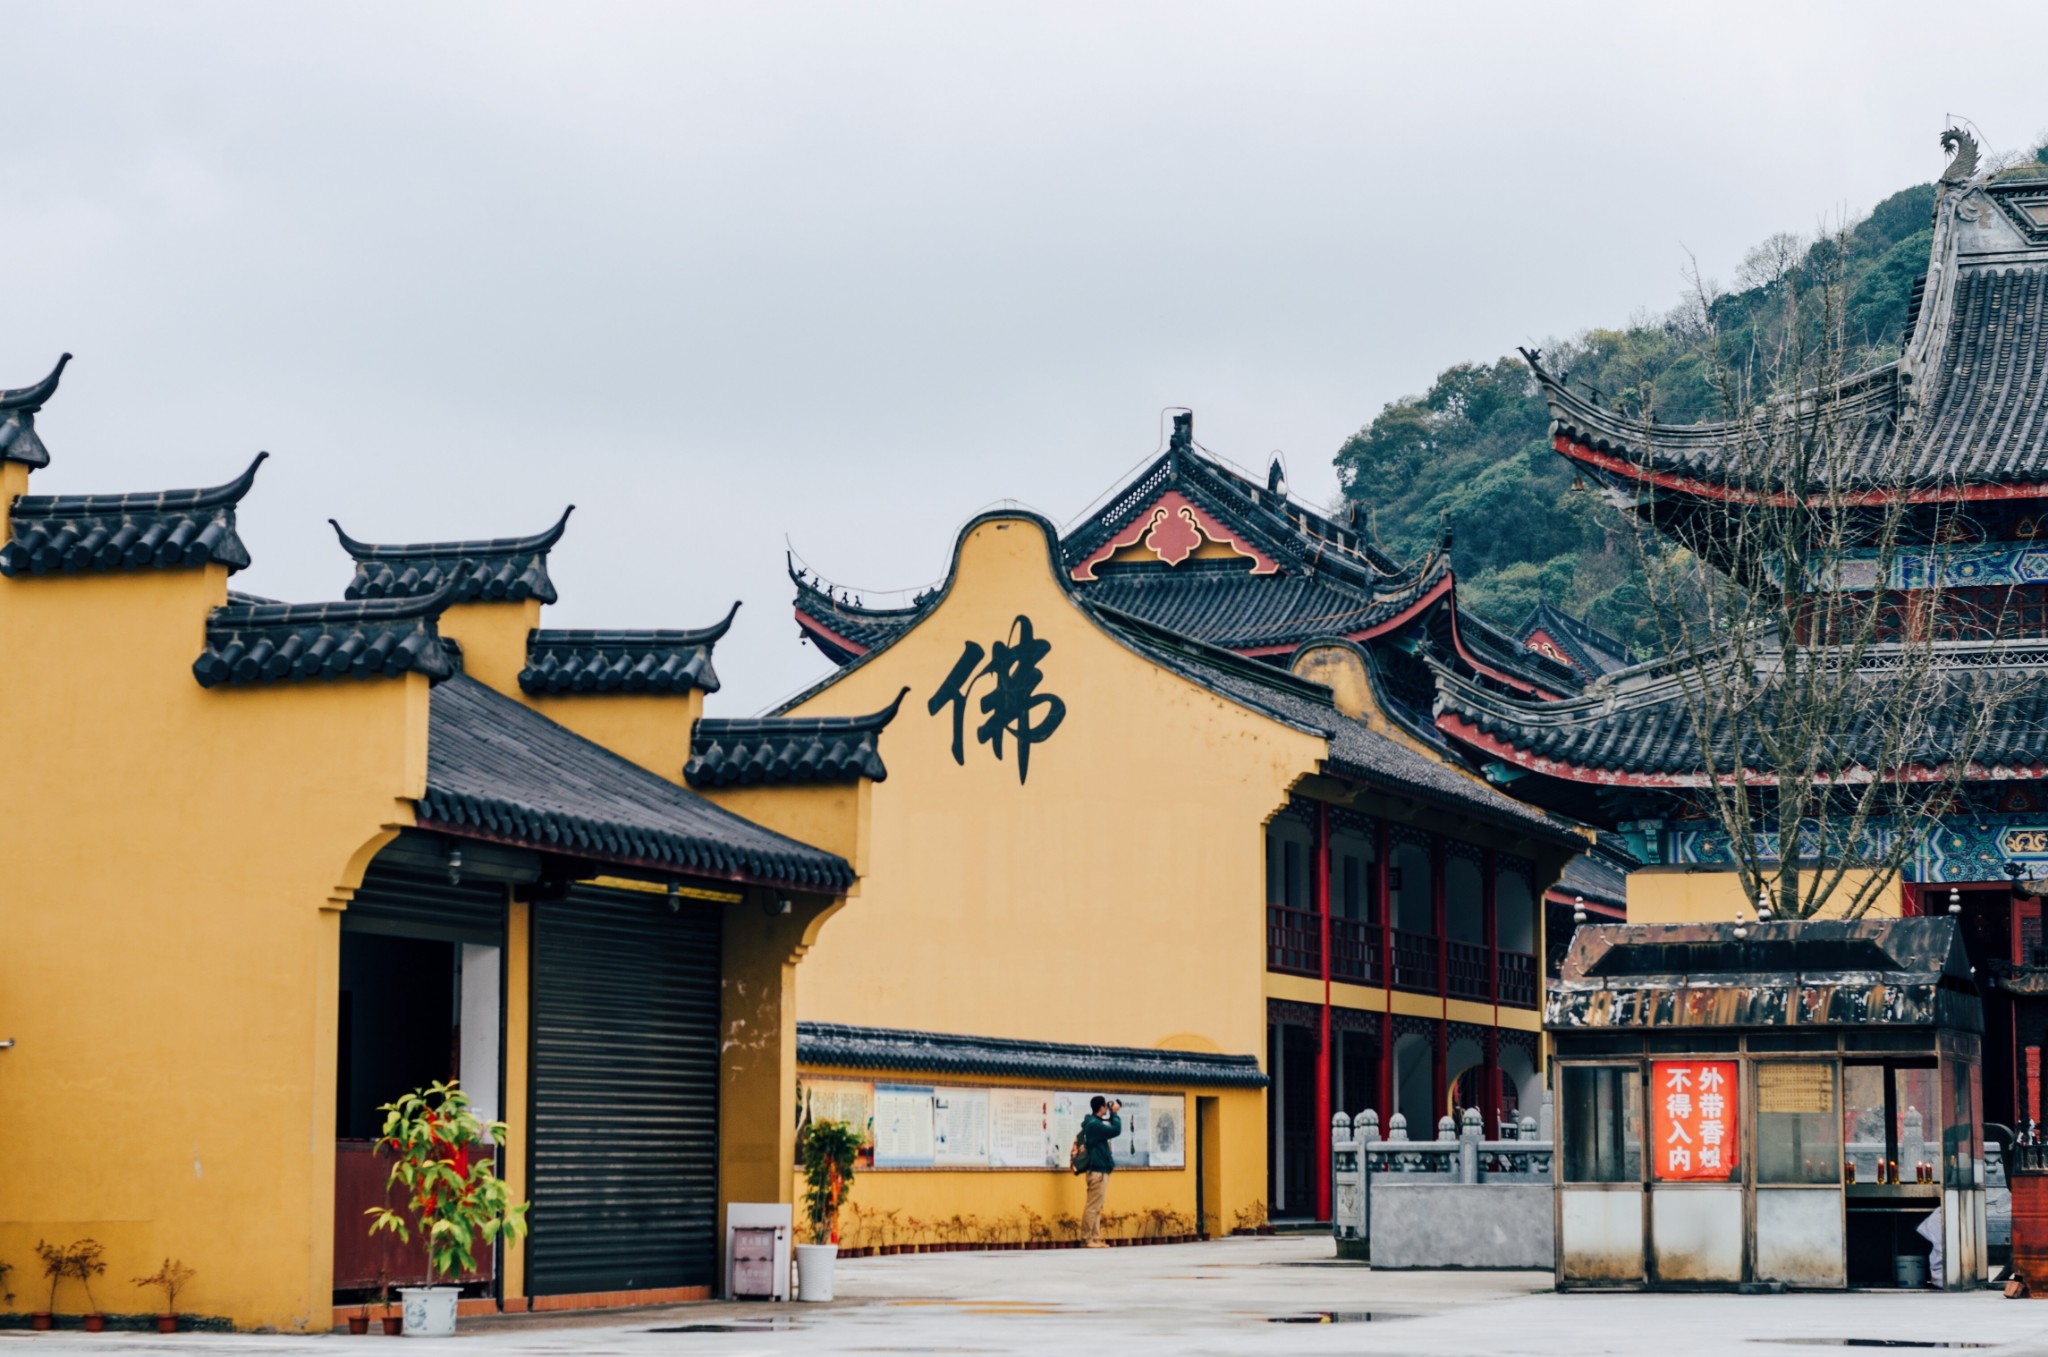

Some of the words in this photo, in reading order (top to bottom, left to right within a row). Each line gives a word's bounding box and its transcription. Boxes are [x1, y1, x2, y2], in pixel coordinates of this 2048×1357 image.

[928, 614, 1066, 786] 佛
[1666, 1069, 1692, 1171] 不得入内
[1699, 1067, 1724, 1168] 外带香烛
